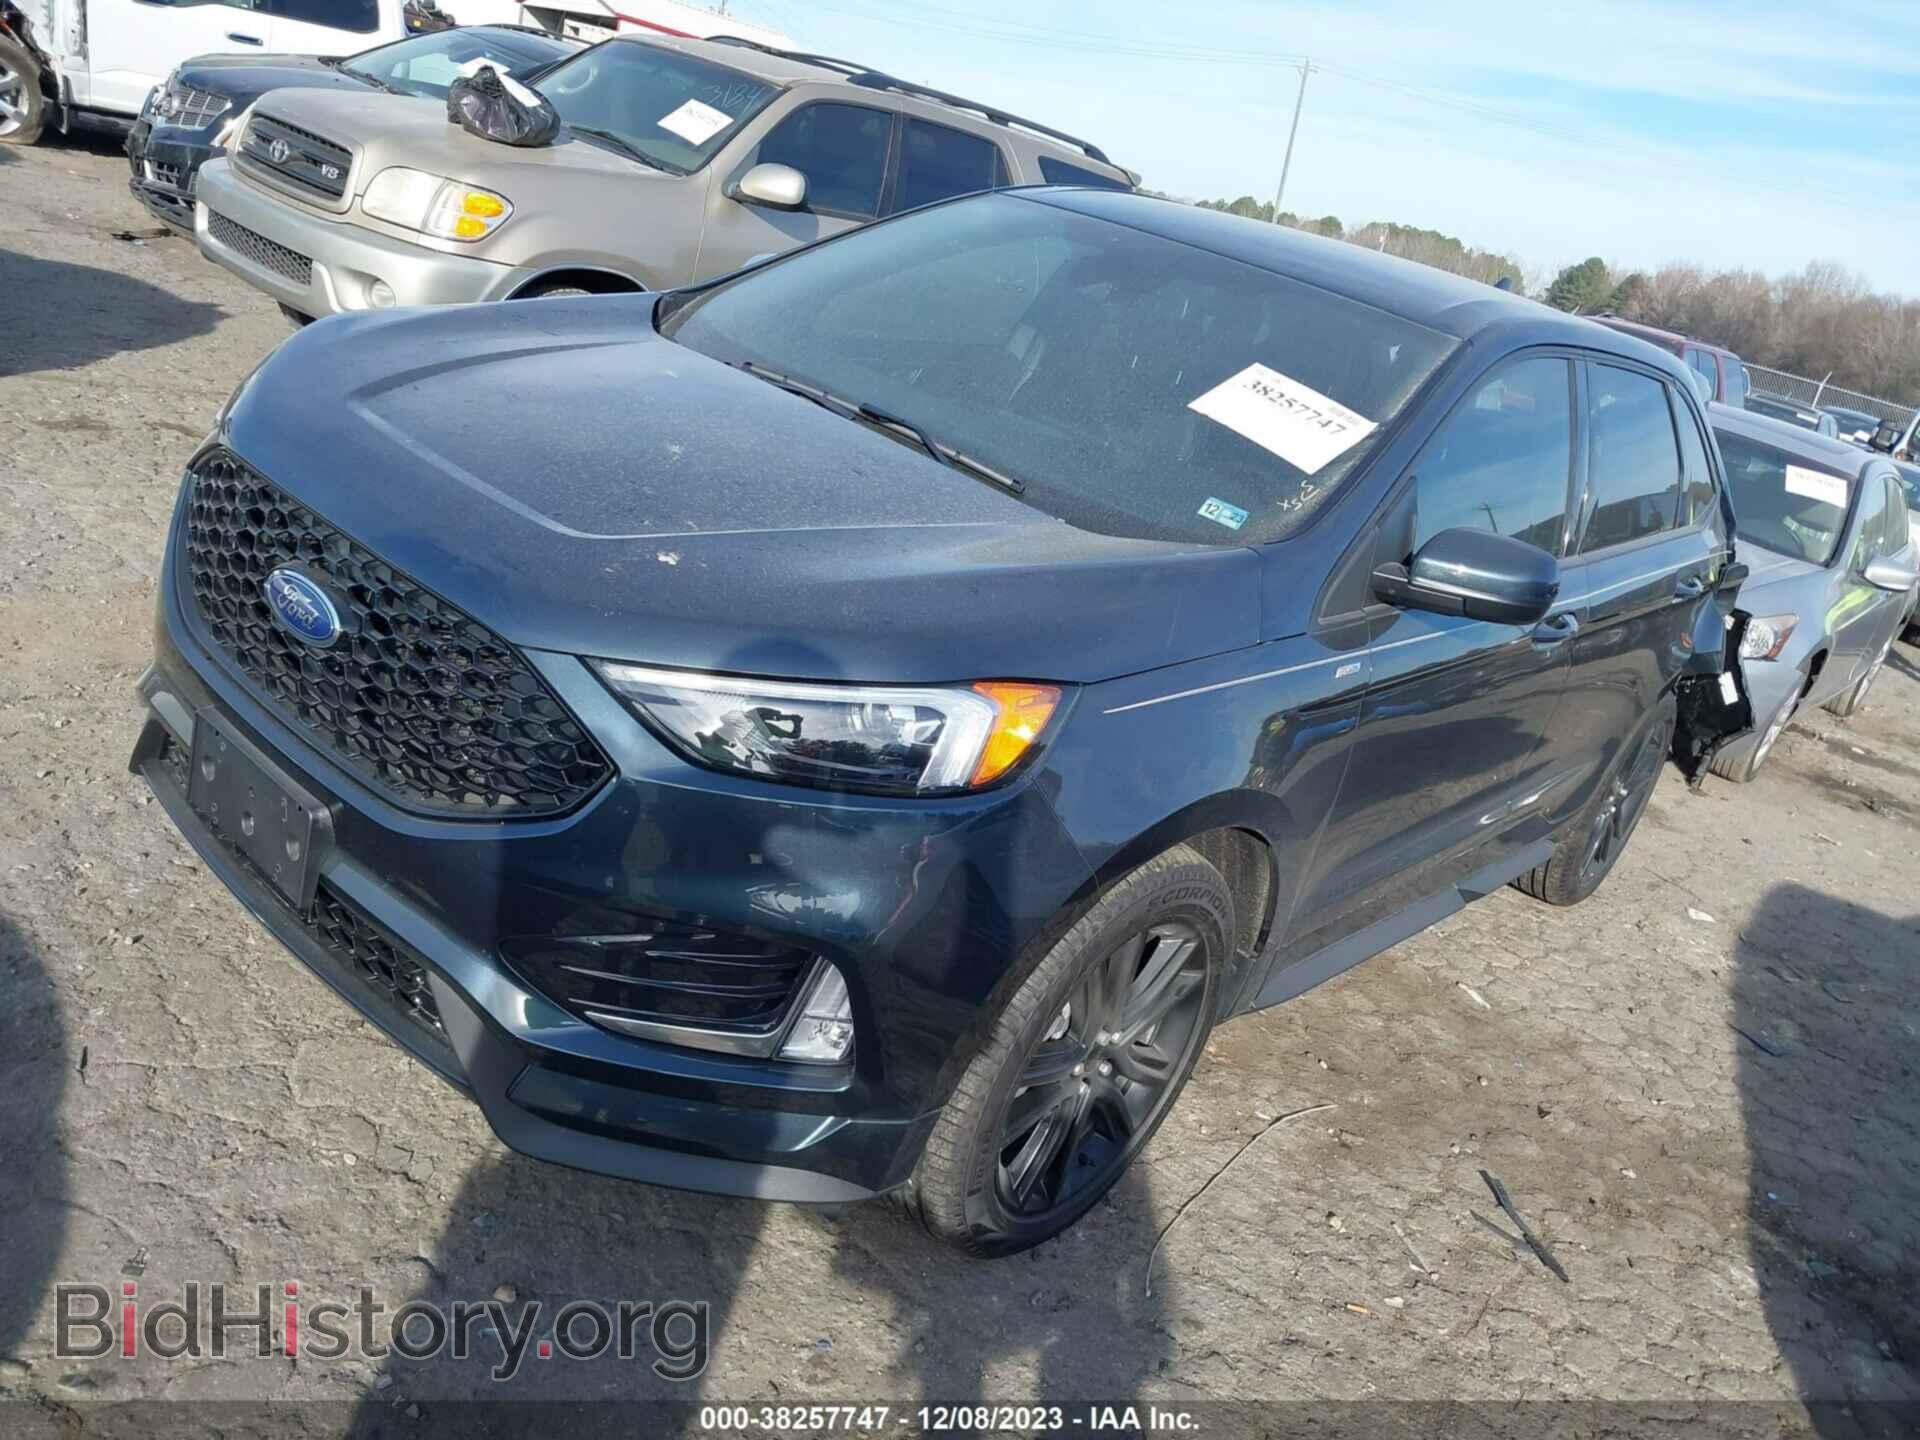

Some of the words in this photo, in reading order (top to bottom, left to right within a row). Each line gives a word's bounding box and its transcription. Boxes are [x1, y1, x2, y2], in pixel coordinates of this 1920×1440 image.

[320, 163, 340, 180] V8
[1242, 379, 1348, 435] 38257747
[1203, 503, 1221, 516] 12
[276, 583, 321, 631] Ford
